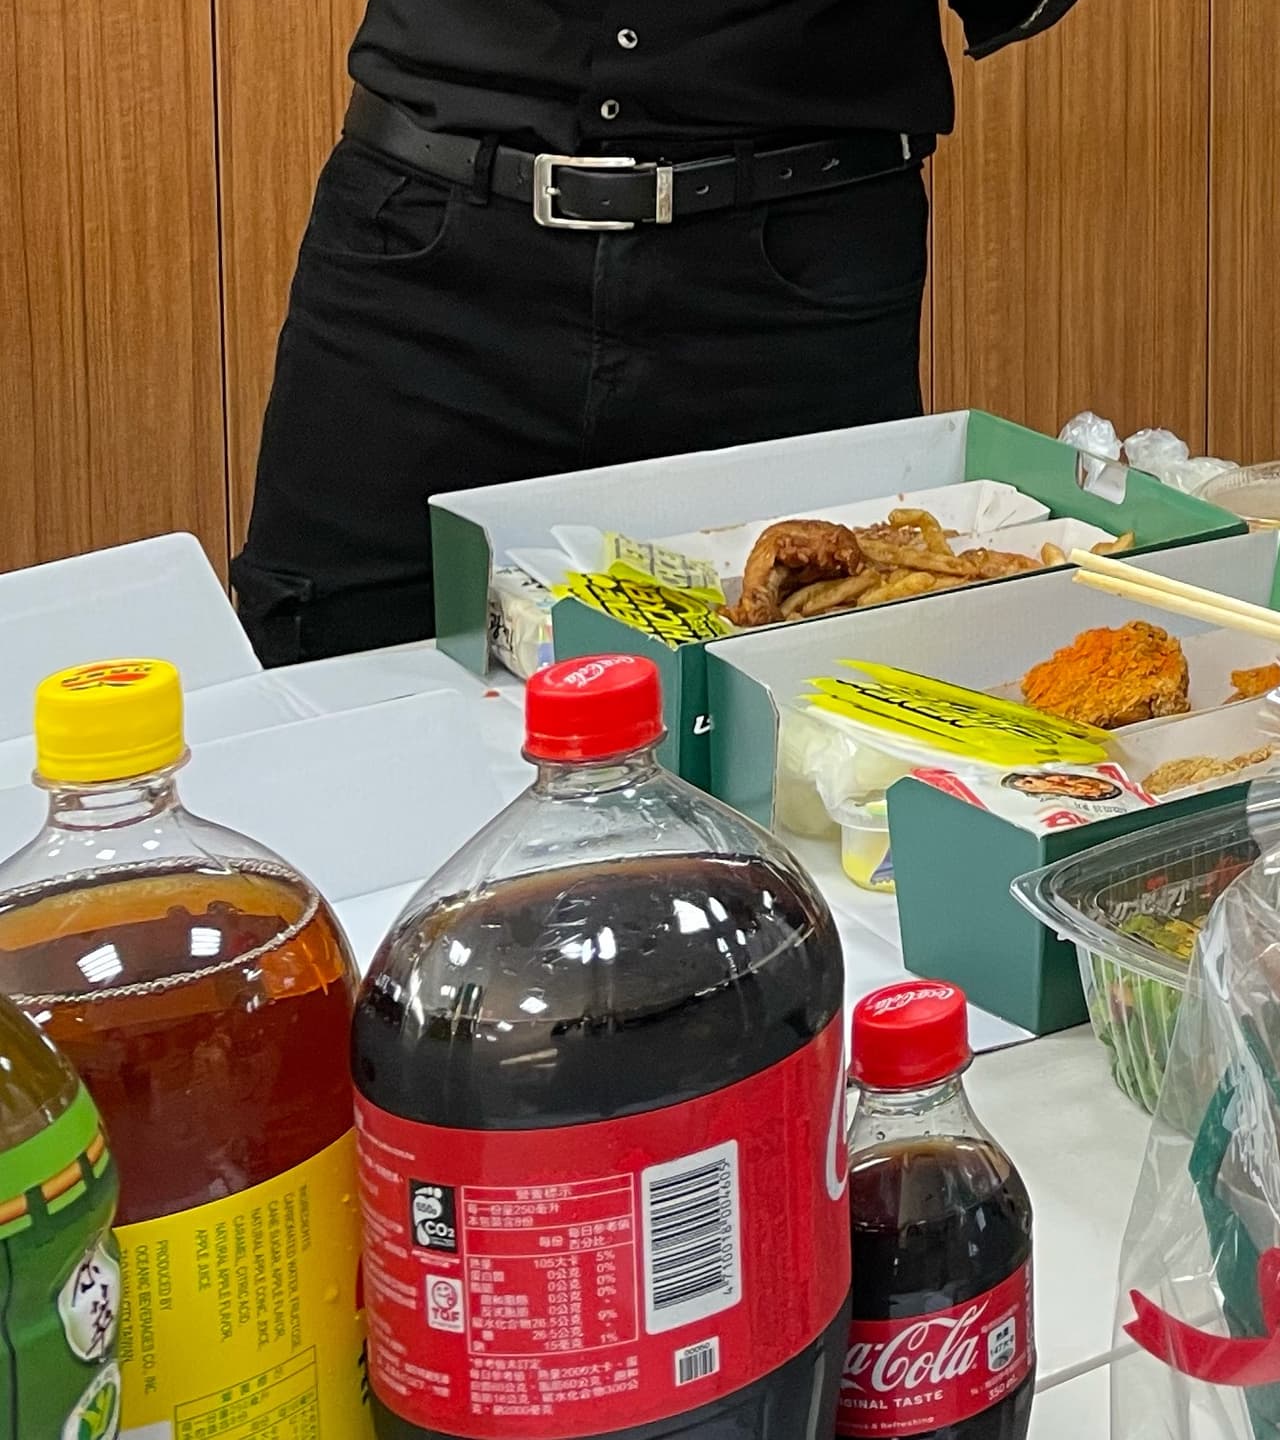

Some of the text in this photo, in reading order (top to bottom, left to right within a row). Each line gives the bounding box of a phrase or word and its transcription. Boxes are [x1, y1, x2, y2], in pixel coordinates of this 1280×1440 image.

[868, 987, 955, 1018] Coca-Cola
[137, 1245, 149, 1289] OCEANIC
[158, 1240, 170, 1295] PRODUCED
[843, 1292, 992, 1393] a-Cola
[894, 1390, 944, 1408] TASTE
